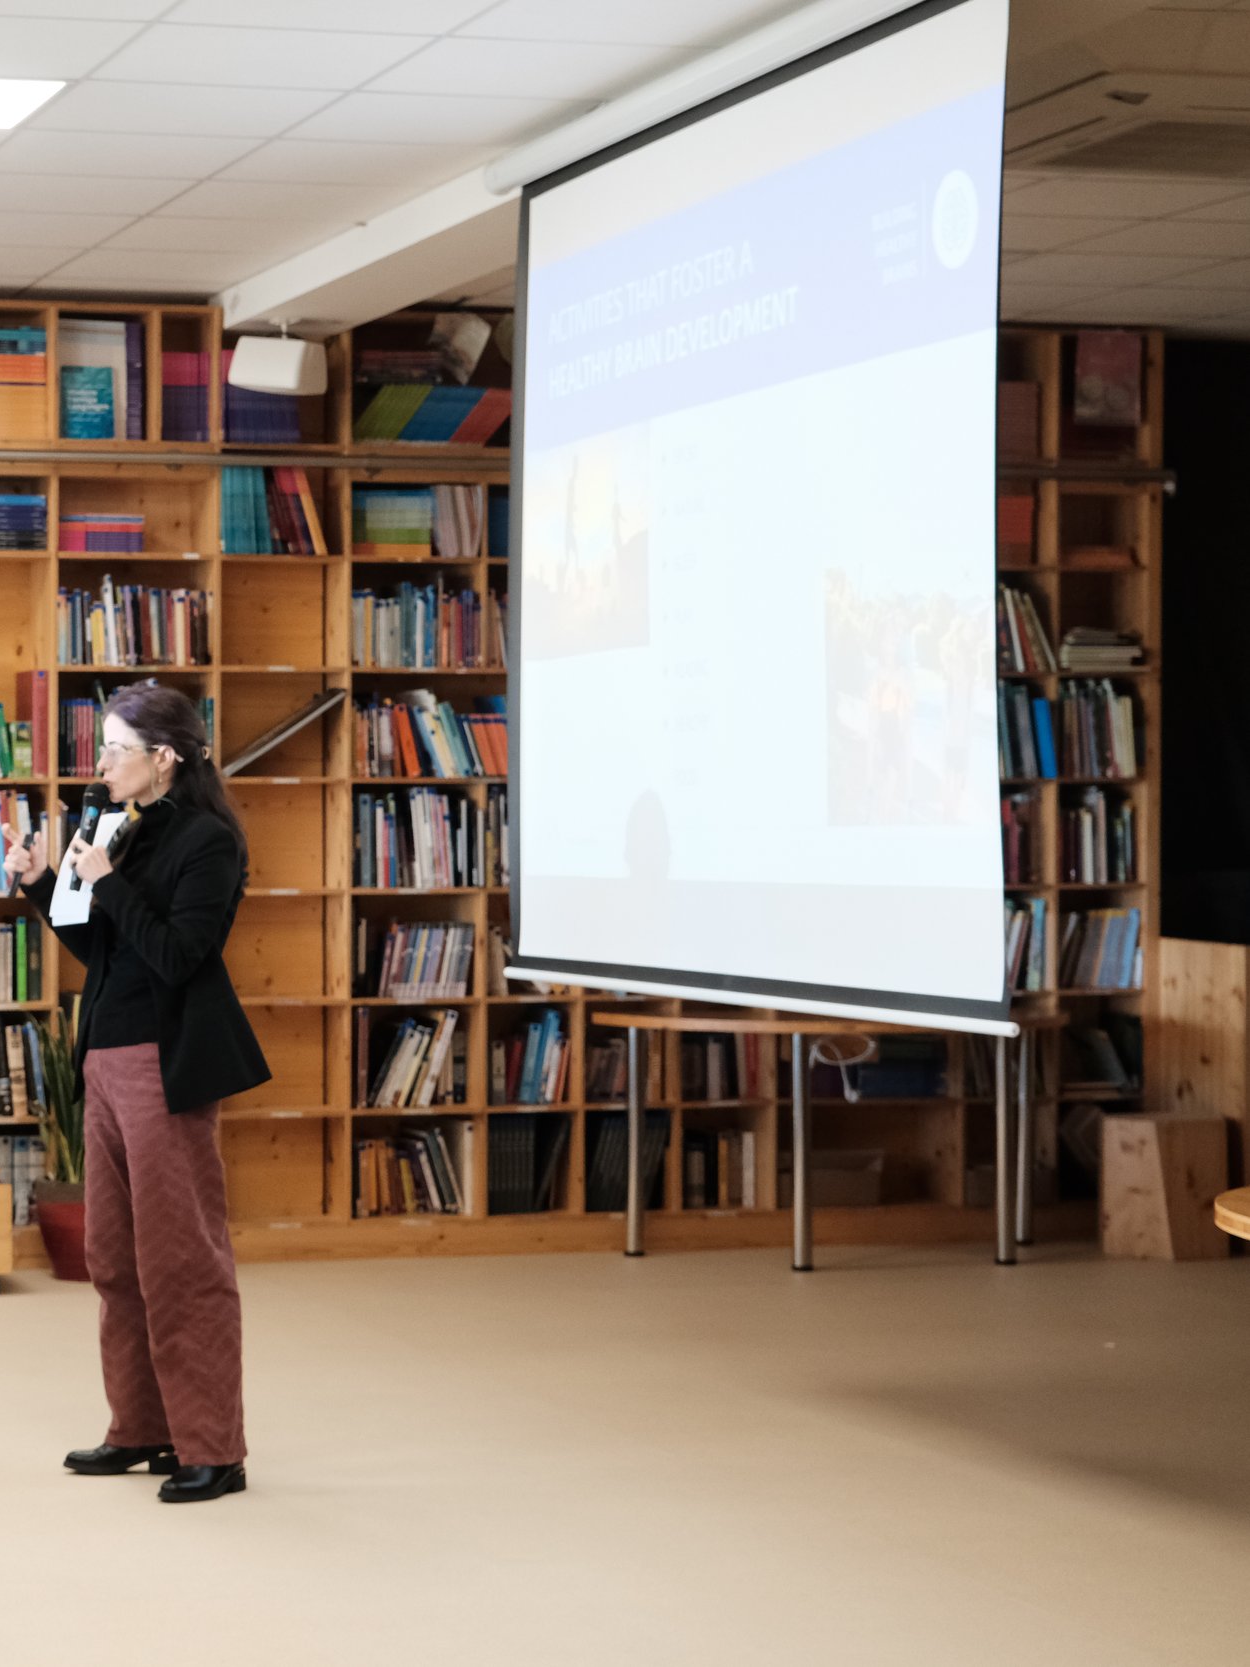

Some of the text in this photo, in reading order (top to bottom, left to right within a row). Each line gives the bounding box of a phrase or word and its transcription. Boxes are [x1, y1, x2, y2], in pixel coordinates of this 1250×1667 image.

[547, 239, 755, 345] ACTIVITIES THAT FOSTER A
[547, 283, 801, 401] HEALTHY BRAIN DEVELOPMENT
